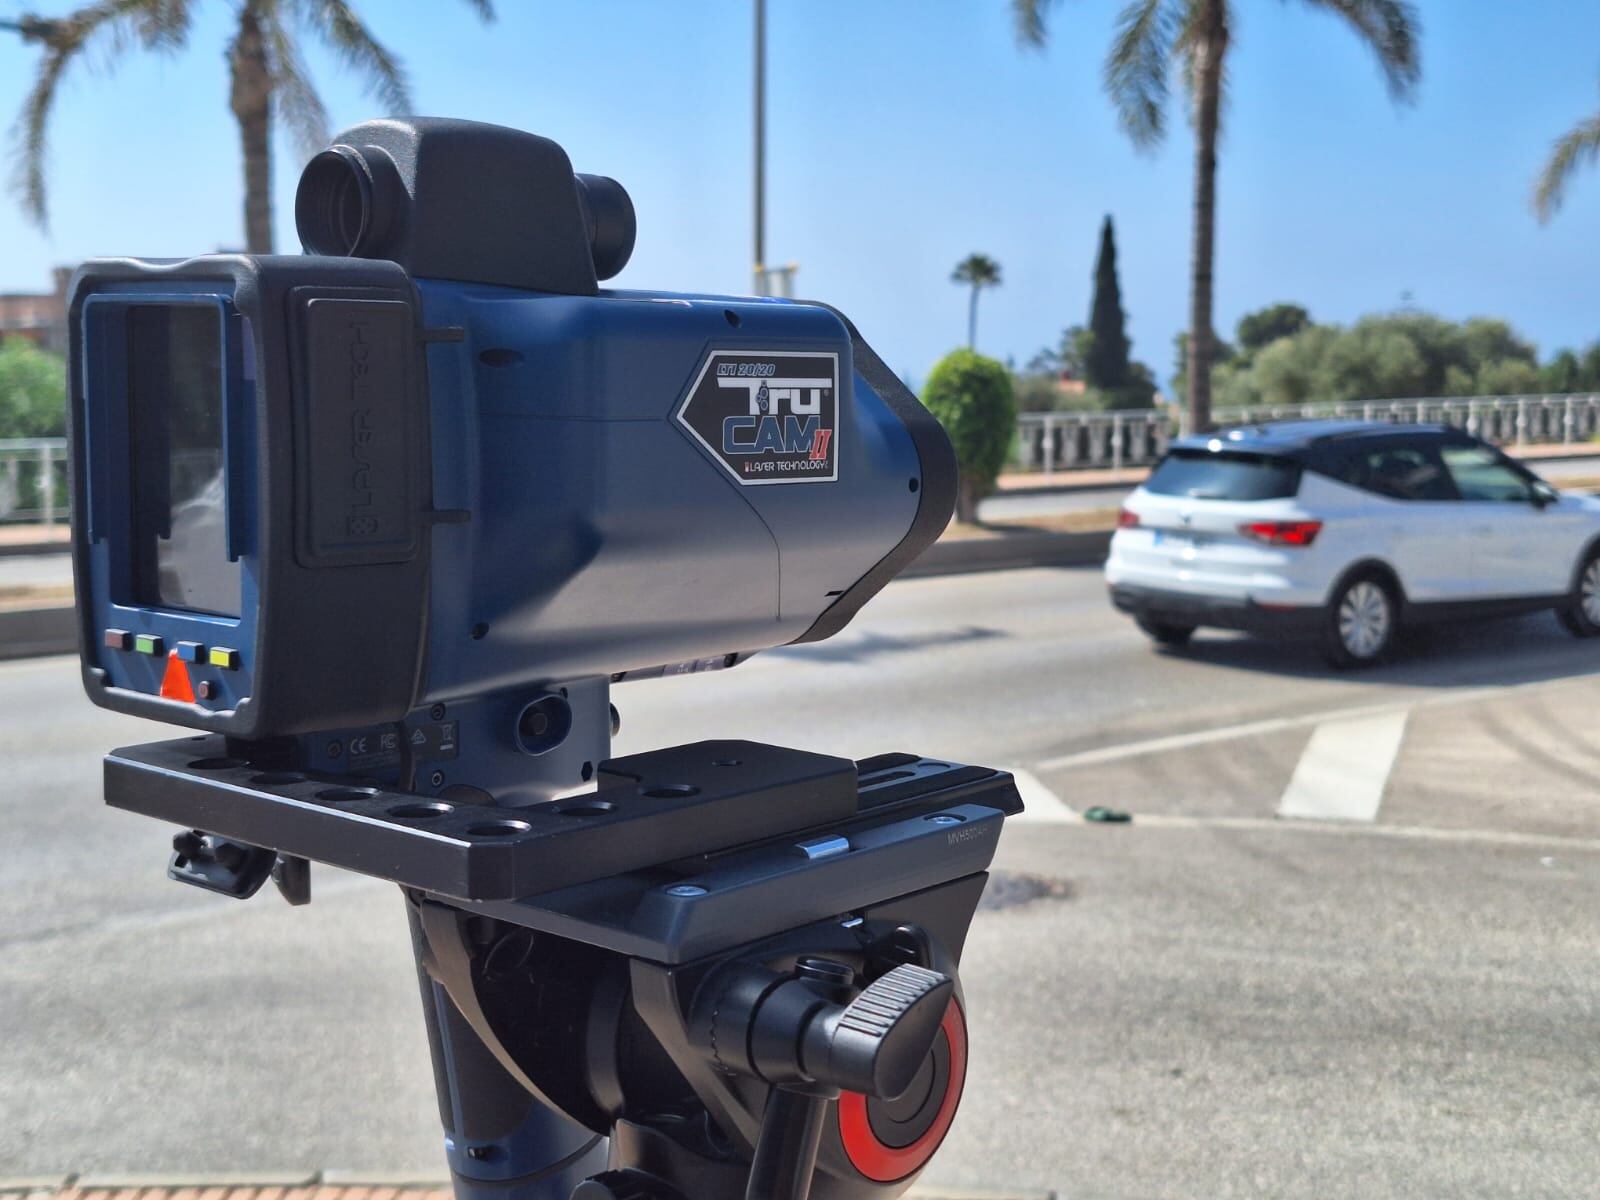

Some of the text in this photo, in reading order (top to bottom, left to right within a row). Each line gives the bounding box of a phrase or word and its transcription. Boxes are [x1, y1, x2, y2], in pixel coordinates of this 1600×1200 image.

[717, 363, 776, 377] LTI 20/20
[723, 415, 832, 460] CAM II
[750, 461, 825, 472] LASER TECHNOLOGY
